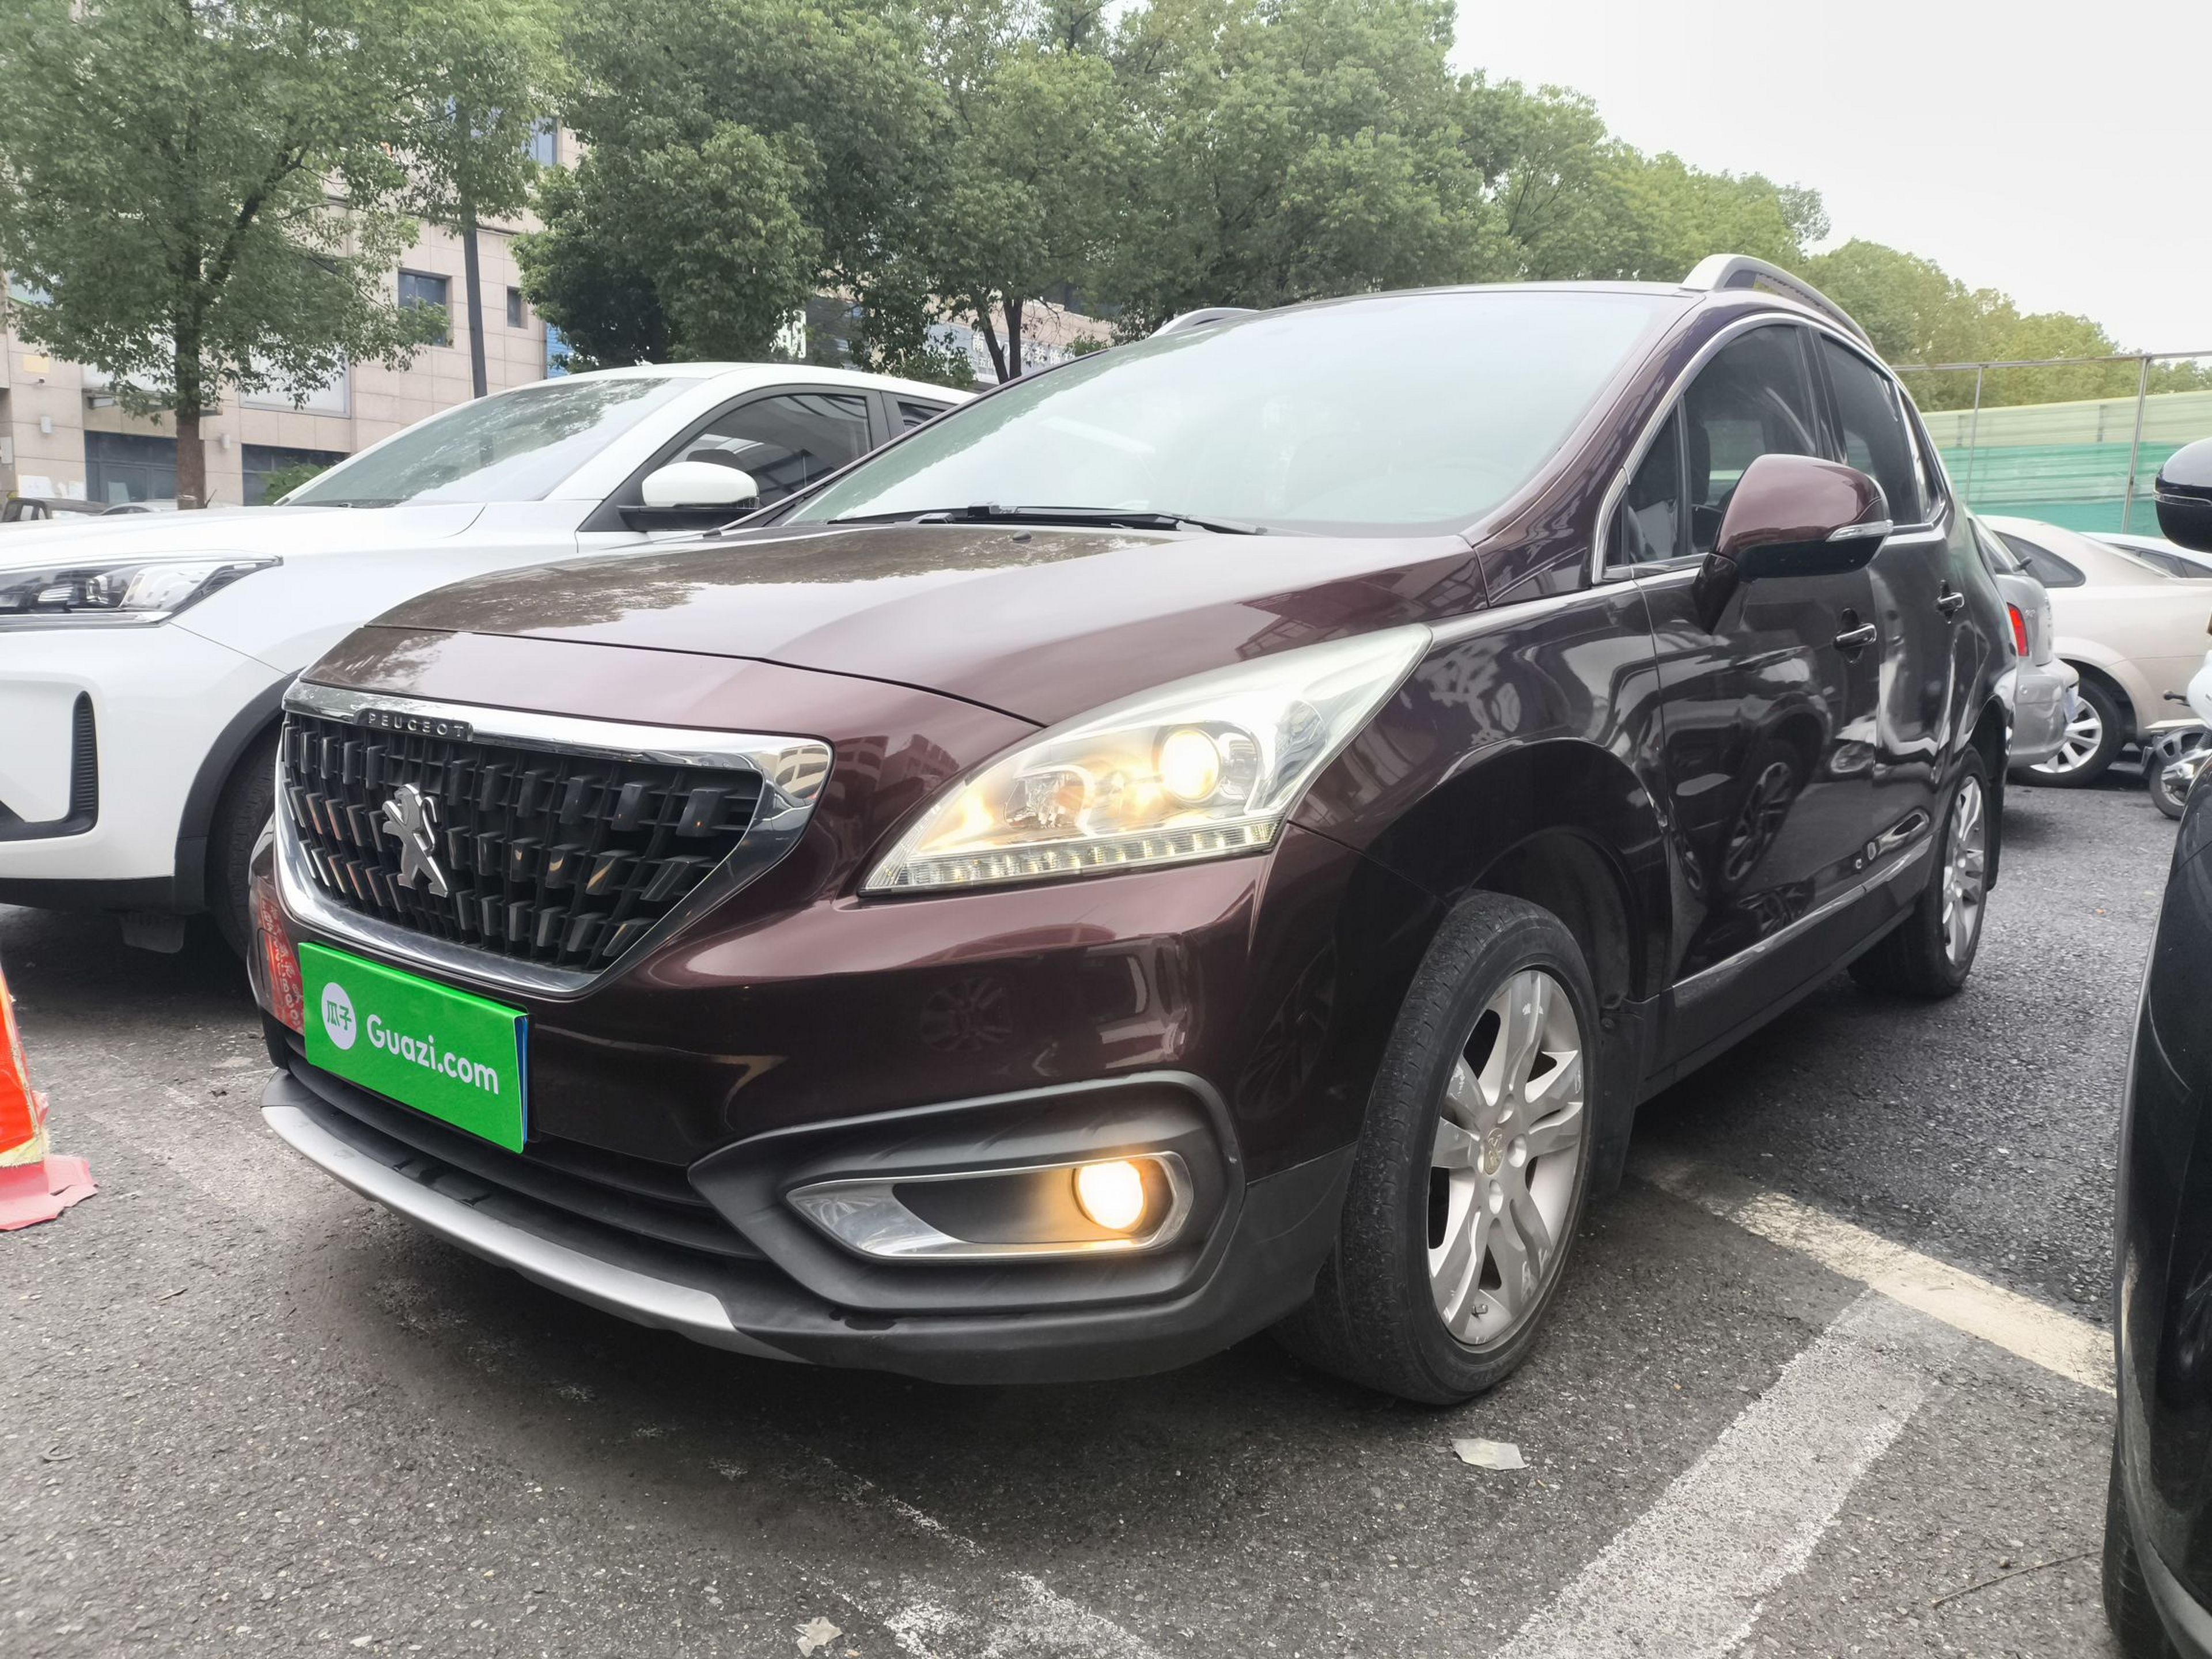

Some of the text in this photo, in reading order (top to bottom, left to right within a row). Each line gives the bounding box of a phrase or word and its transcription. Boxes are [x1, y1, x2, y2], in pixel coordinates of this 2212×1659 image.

[369, 712, 464, 737] PEUGEOT
[327, 999, 352, 1031] 瓜子
[366, 1014, 499, 1095] Guazi.com
